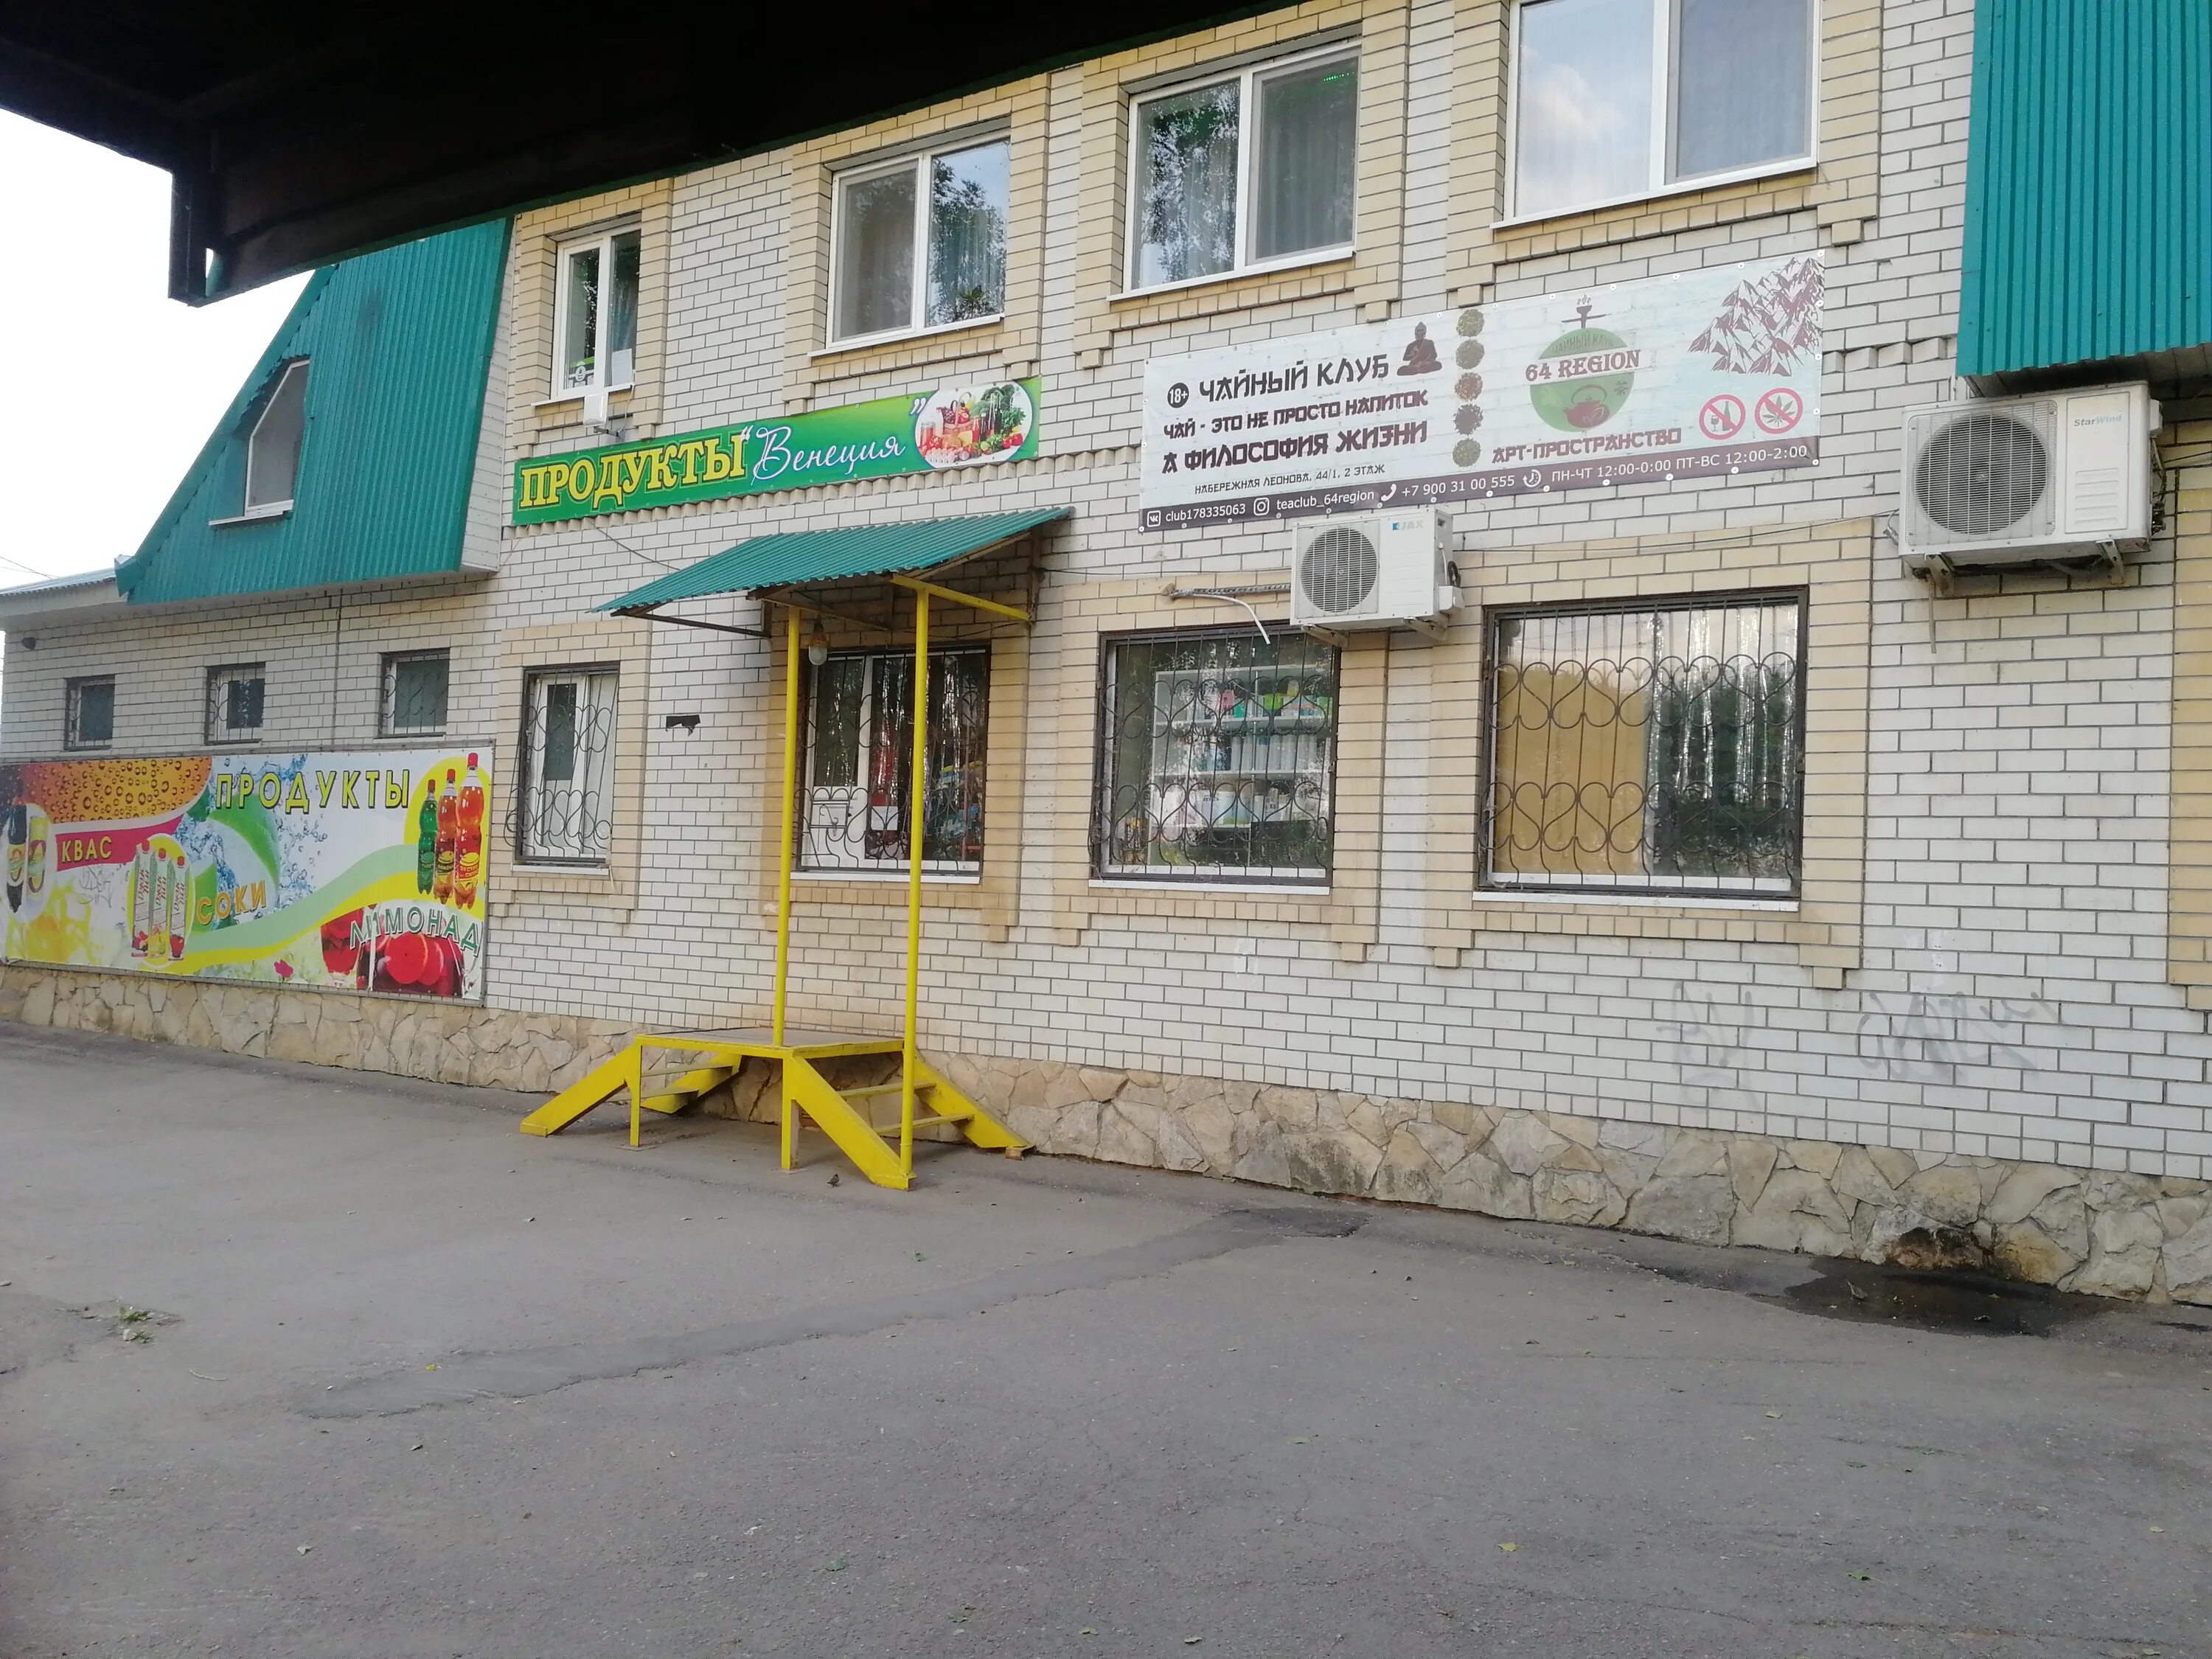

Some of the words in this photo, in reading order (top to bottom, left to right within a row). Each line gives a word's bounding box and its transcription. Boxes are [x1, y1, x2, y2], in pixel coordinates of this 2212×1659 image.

[1200, 360, 1308, 403] ЧАЙНЫЙ
[1317, 354, 1389, 387] КЛУБ
[1526, 363, 1552, 382] 64
[1558, 349, 1641, 378] REGION
[1168, 387, 1189, 405] 18+
[1164, 417, 1195, 439] ЧАЙ
[1211, 414, 1242, 434] ЭТО
[1247, 411, 1268, 429] НЕ
[1273, 401, 1340, 425] ПРОСТО
[1346, 389, 1429, 416] НАПИТОК
[2073, 414, 2122, 427] StarWind
[1161, 451, 1178, 474] А
[1184, 432, 1329, 470] ФИЛОСОФИЯ
[1335, 420, 1428, 453] ЖИЗНИ
[1492, 427, 1682, 464] АРТ-ПРОСТРАНСТВО
[519, 434, 746, 509] ПРОДУКТЫ
[1194, 478, 1260, 495] НАБЕРЕЖНАЯ
[1344, 467, 1351, 478] 2
[1354, 464, 1385, 477] ЭТАЖ
[1552, 467, 1593, 482] ПН-ЧТ
[1597, 459, 1672, 478] 12:00-0:00
[1676, 454, 1720, 470] ПТ-ВС
[1725, 445, 1807, 465] 12:00-2:00
[1276, 490, 1374, 510] teaclub_64region
[1402, 485, 1419, 498] +7
[1423, 482, 1446, 496] 900
[1450, 480, 1466, 493] 31
[1470, 478, 1486, 490] 00
[1491, 475, 1515, 489] 555
[1165, 503, 1246, 522] club178335063
[215, 769, 410, 815] ПРОДУКТЫ
[61, 836, 112, 863] КВАС
[197, 880, 266, 926] СОКИ
